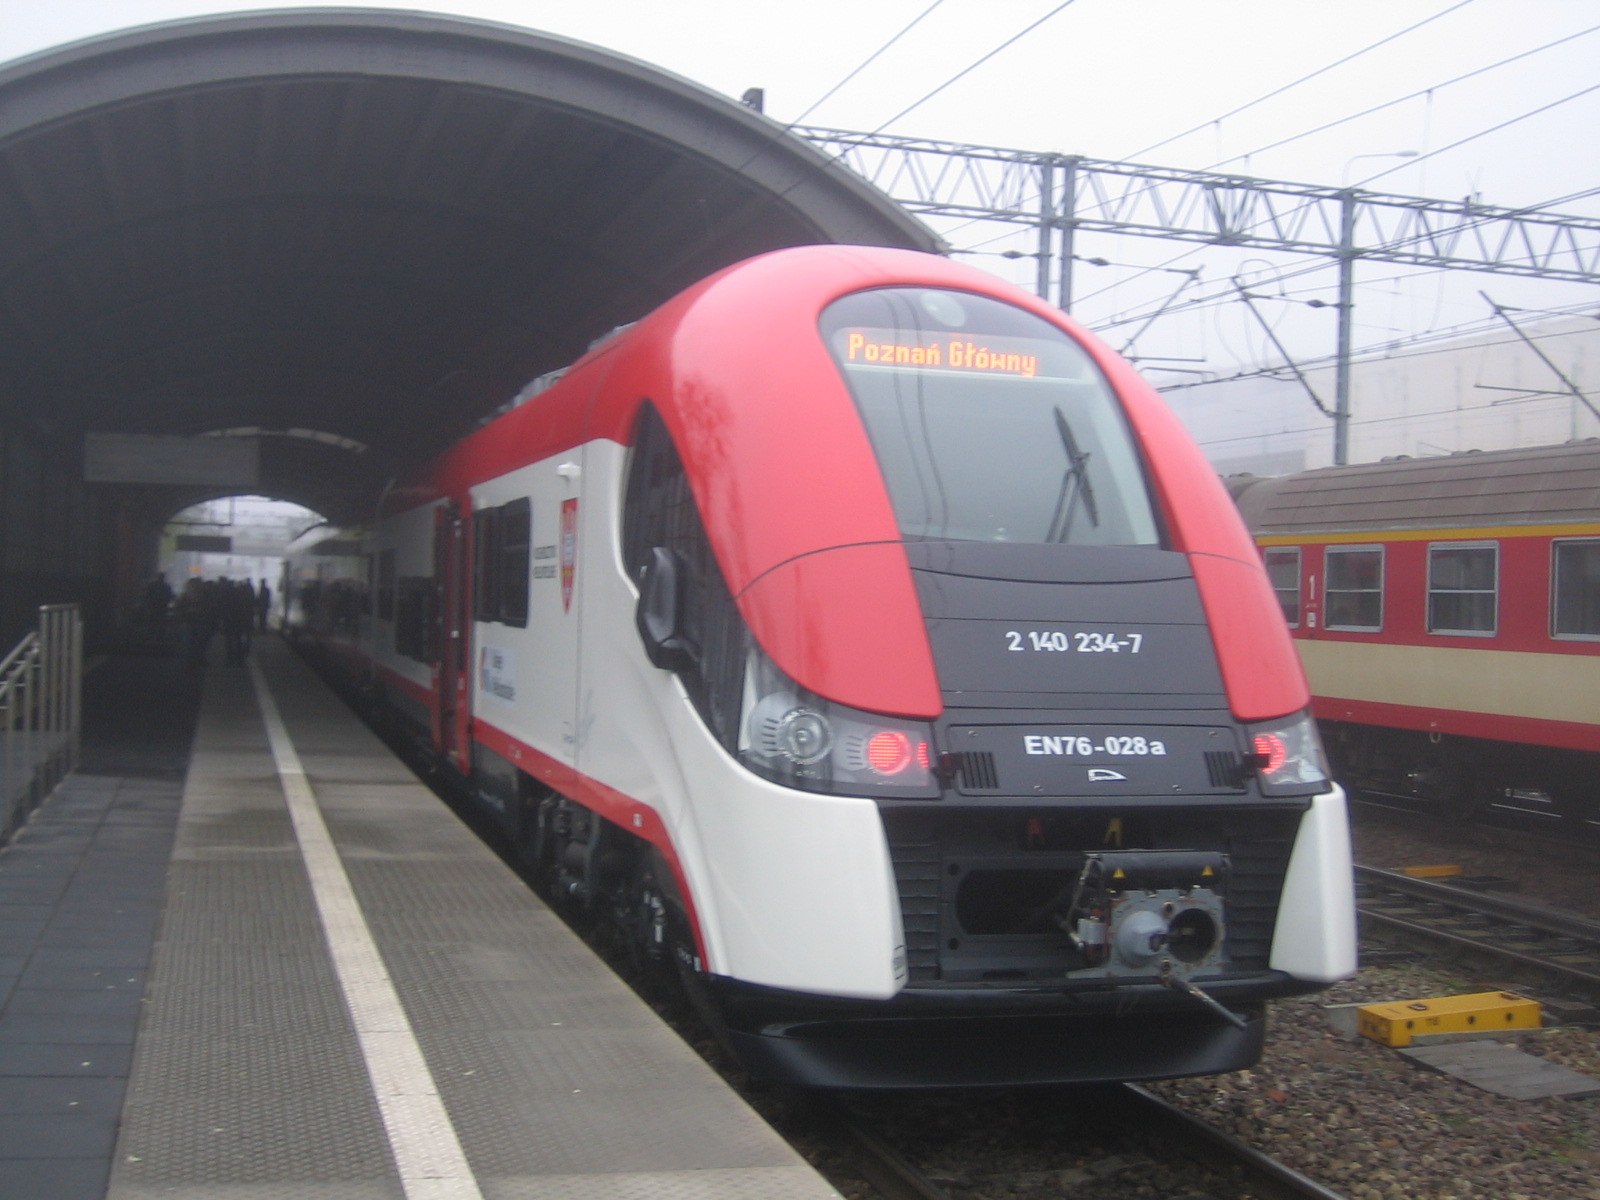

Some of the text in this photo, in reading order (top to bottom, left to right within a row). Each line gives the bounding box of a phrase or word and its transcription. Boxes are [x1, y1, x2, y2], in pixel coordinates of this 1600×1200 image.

[849, 332, 1037, 378] Poznań Główny
[1308, 574, 1316, 600] 1
[1005, 630, 1143, 654] 2 140 234-7
[1023, 735, 1167, 756] EN76-028a
